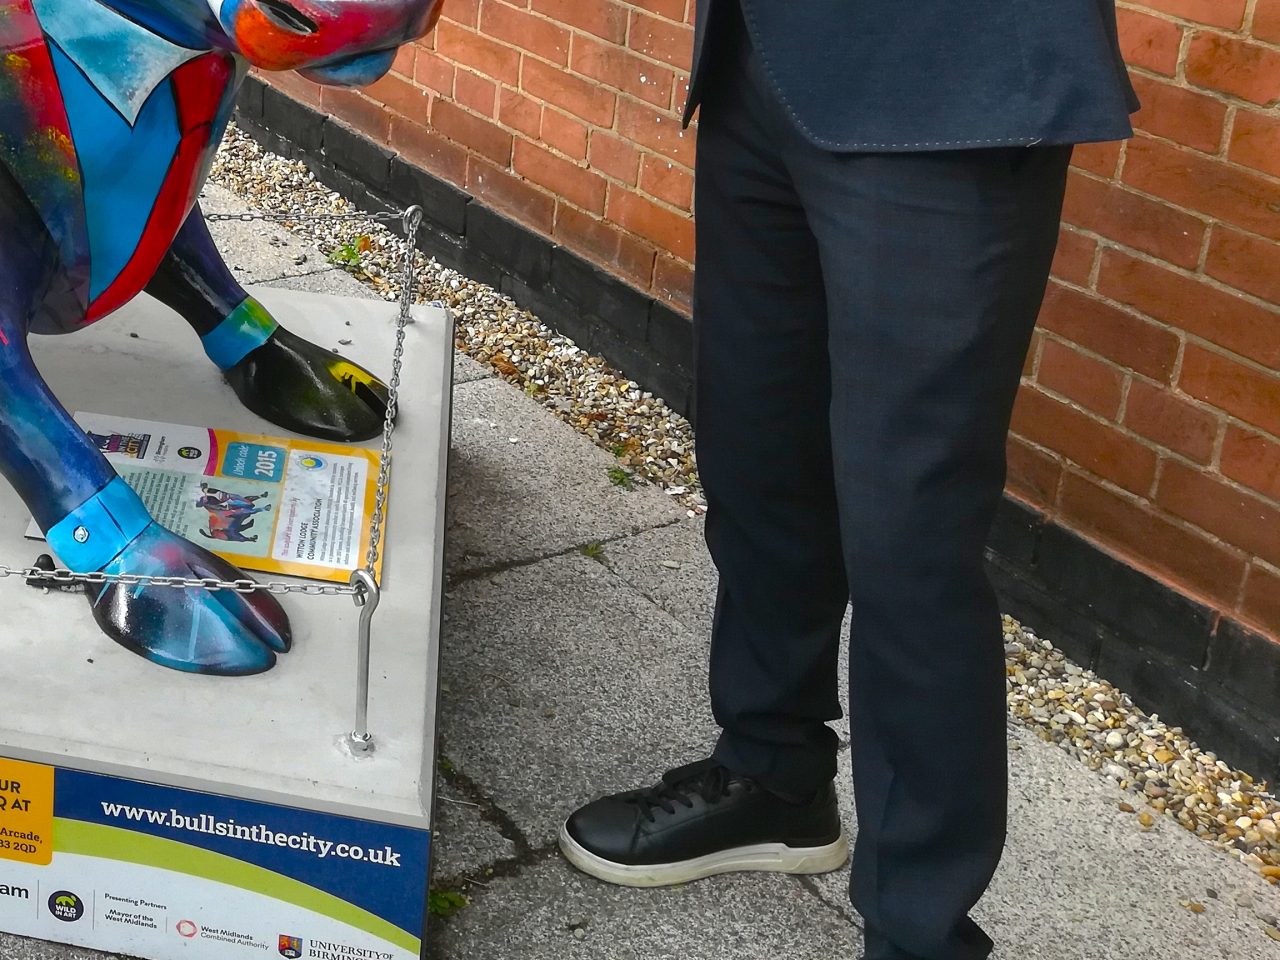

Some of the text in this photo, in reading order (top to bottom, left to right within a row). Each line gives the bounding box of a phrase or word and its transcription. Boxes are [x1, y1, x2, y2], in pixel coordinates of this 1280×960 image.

[254, 450, 278, 478] 2015
[300, 522, 309, 539] LODGE
[307, 498, 322, 560] COMMUNITY ASSOCIATION
[11, 798, 31, 812] AT
[0, 826, 43, 844] Arcade,
[100, 800, 401, 867] www.bullsinthecity.co.uk
[13, 841, 37, 854] 2QD
[55, 904, 76, 914] WILD
[104, 893, 167, 910] Presenting Partners
[105, 914, 157, 929] West Midlands
[109, 909, 132, 917] Mayor
[200, 932, 269, 950] Combined Authority
[201, 925, 253, 941] West Midlands
[310, 940, 381, 960] UNIVERSITY
